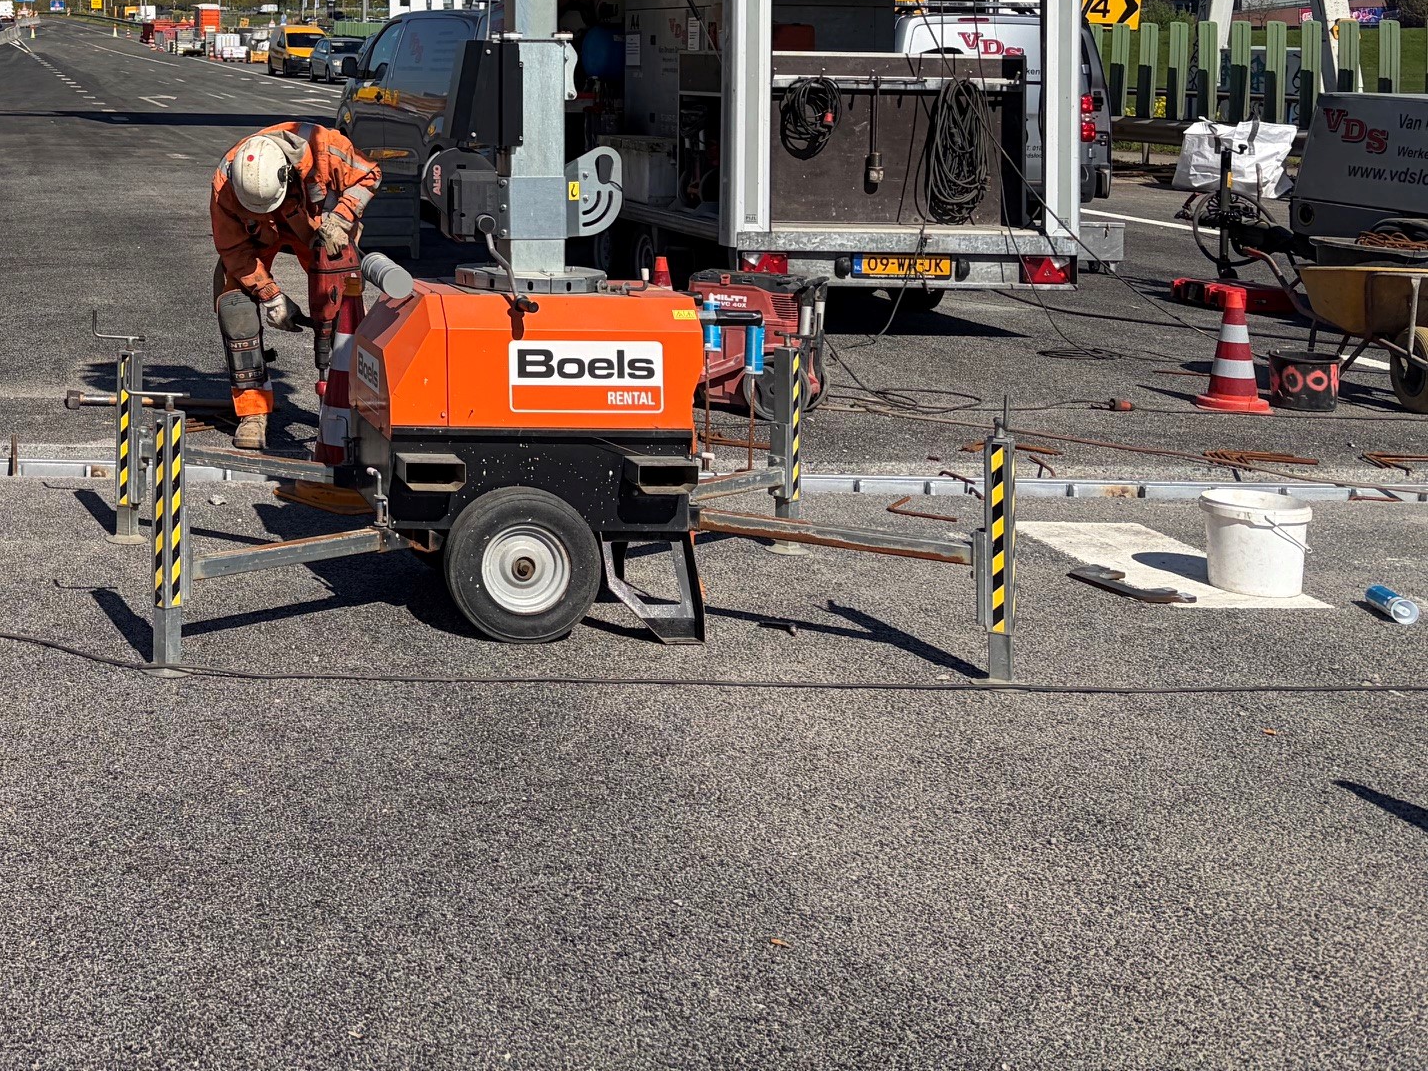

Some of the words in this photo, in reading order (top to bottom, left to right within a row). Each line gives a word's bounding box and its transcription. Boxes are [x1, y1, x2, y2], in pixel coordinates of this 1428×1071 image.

[1323, 107, 1389, 155] VDS
[1398, 113, 1423, 131] Van
[708, 292, 748, 303] HILTI
[357, 351, 379, 389] Boels
[517, 348, 656, 380] Boels
[607, 391, 656, 406] RENTAL
